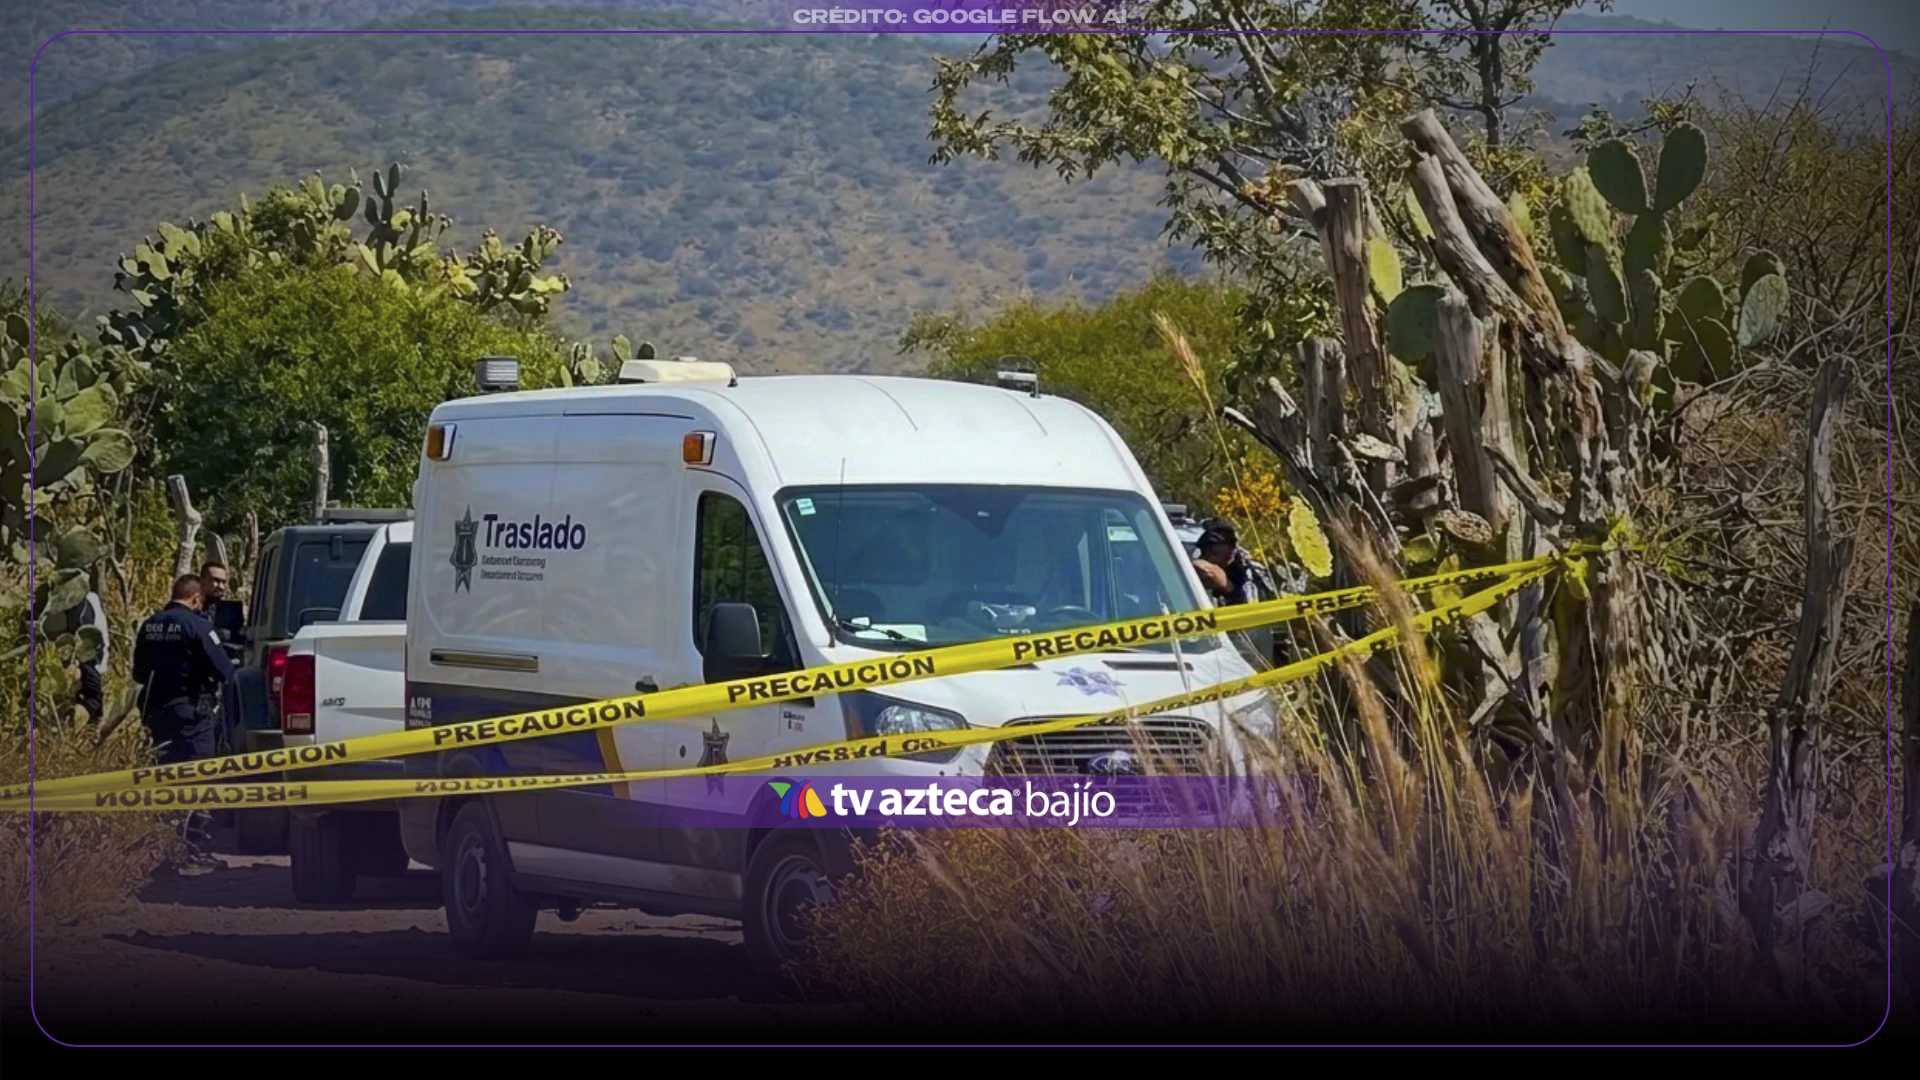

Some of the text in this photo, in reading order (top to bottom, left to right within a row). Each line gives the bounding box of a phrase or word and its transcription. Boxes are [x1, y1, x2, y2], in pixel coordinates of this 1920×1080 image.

[483, 513, 587, 550] Traslado
[727, 654, 935, 703] PRECAUCIÓN
[131, 742, 347, 785] PRECAUCION
